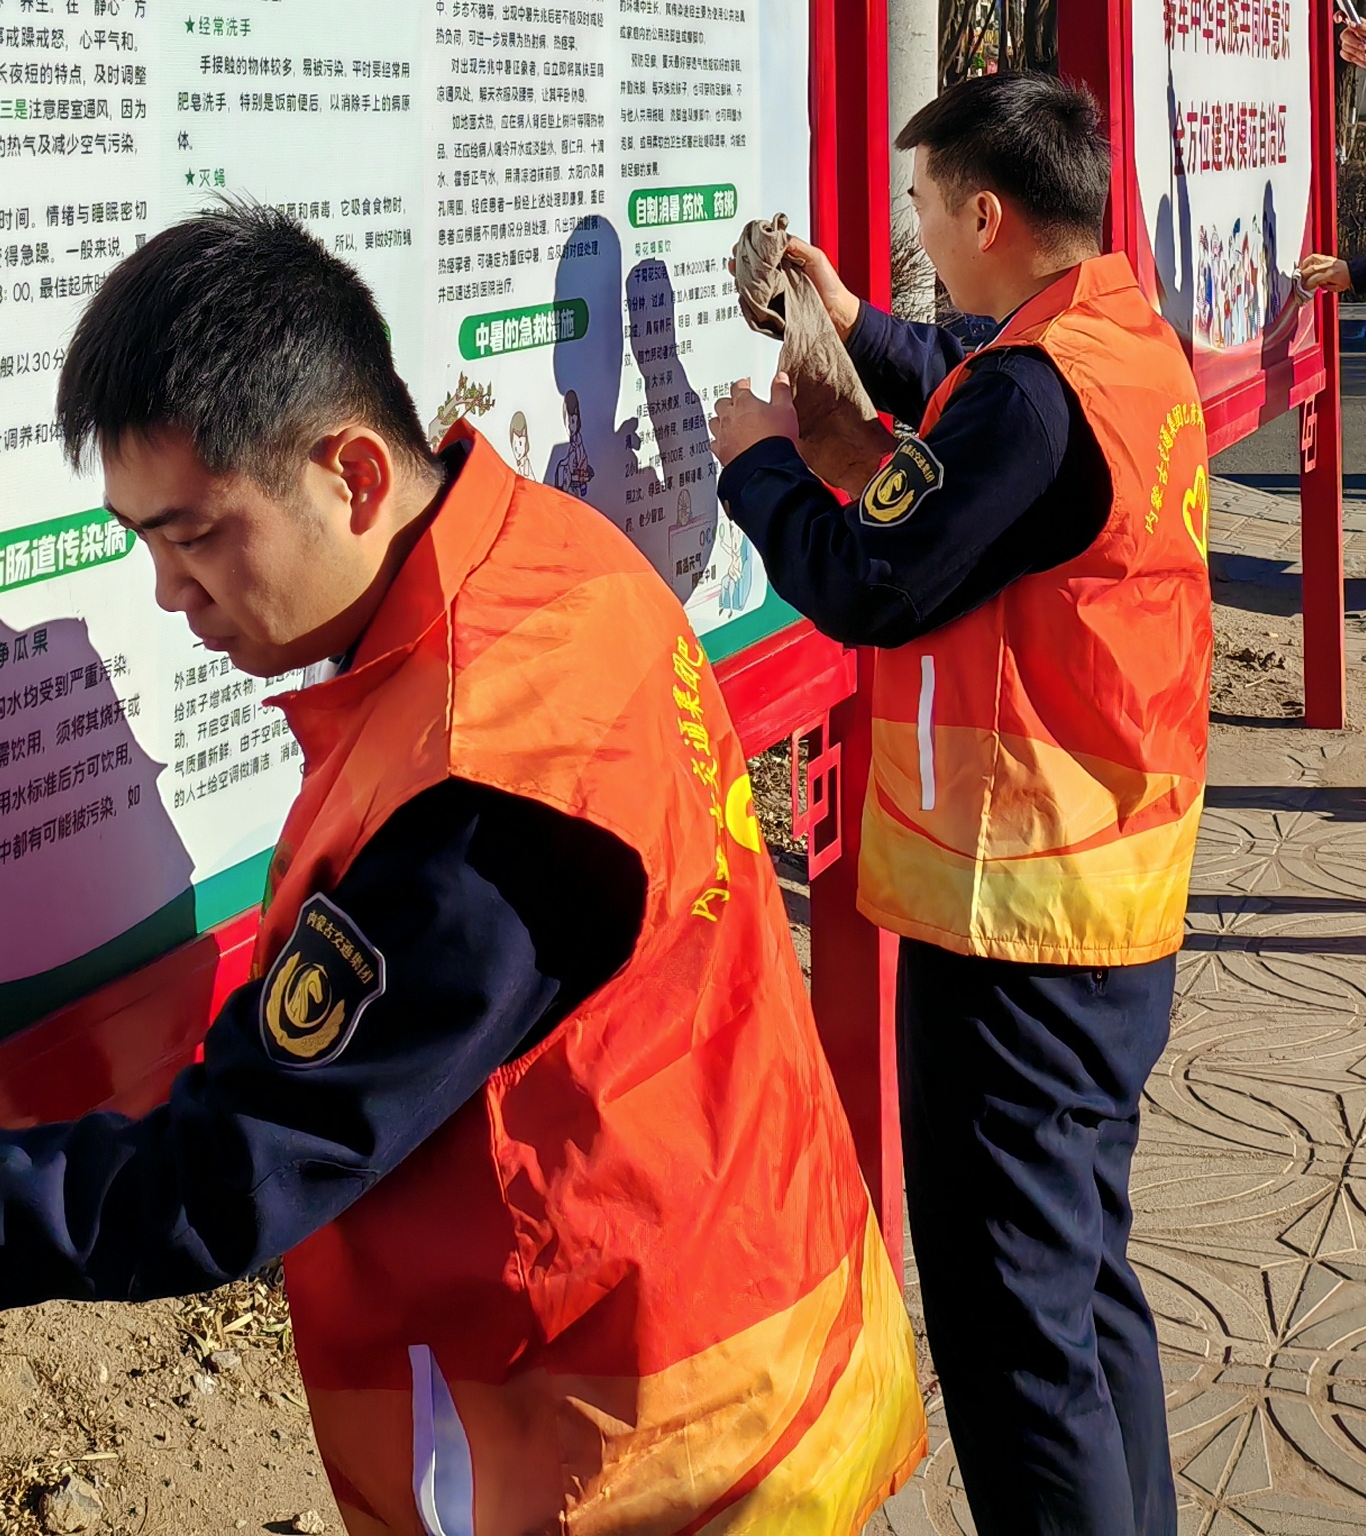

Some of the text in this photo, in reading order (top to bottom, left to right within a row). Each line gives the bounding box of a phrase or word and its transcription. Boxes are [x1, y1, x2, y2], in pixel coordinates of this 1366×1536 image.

[198, 15, 252, 37] 经常洗手
[177, 130, 194, 151] 体。
[1172, 100, 1288, 176] 全方位建设模范自治区
[475, 308, 575, 355] 中暑的急救措施
